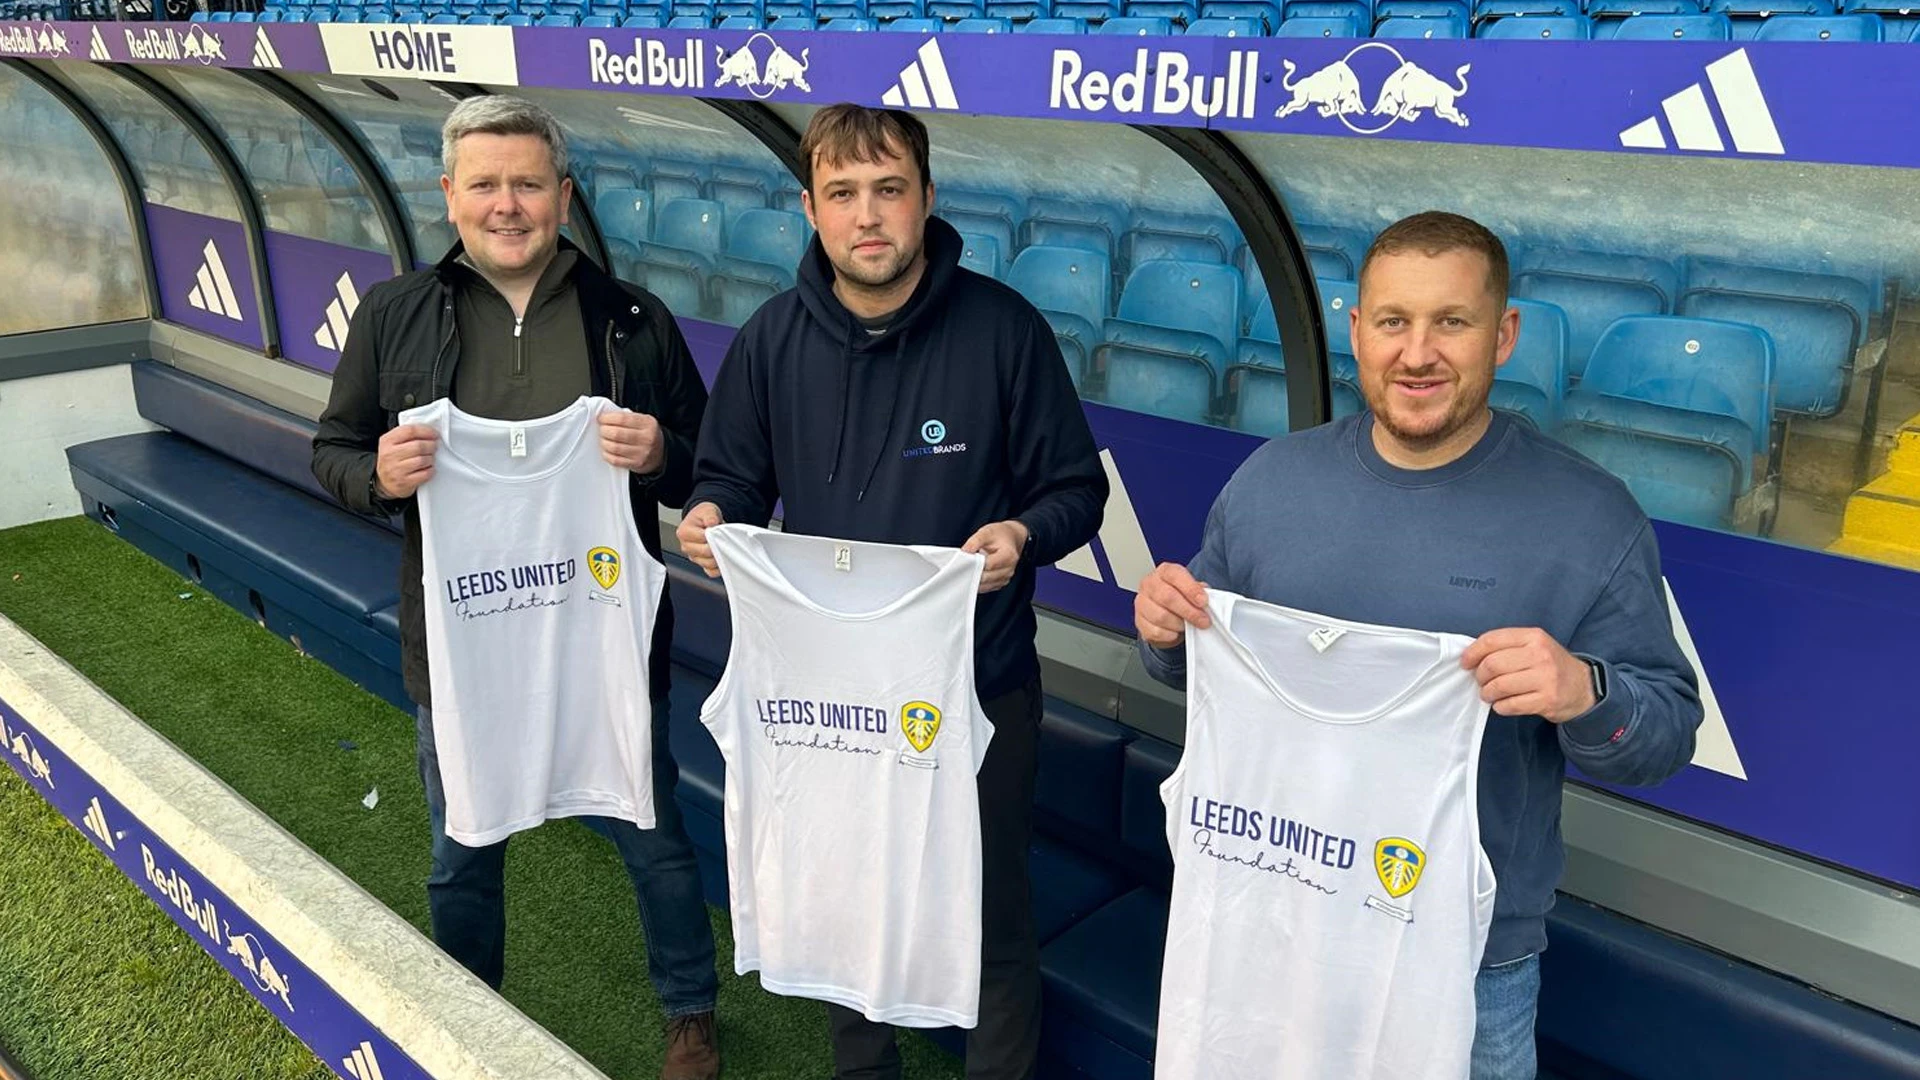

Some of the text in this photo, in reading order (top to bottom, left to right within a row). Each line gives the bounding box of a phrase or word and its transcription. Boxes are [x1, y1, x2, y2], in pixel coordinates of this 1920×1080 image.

[369, 30, 456, 73] HOME
[446, 558, 576, 604] LEEDS UNITED
[455, 592, 570, 622] Foundation
[756, 698, 888, 734] LEEDS UNITED
[764, 723, 882, 756] Foundation
[1190, 796, 1356, 870] LEEDS UNITED
[1193, 828, 1338, 895] Foundation
